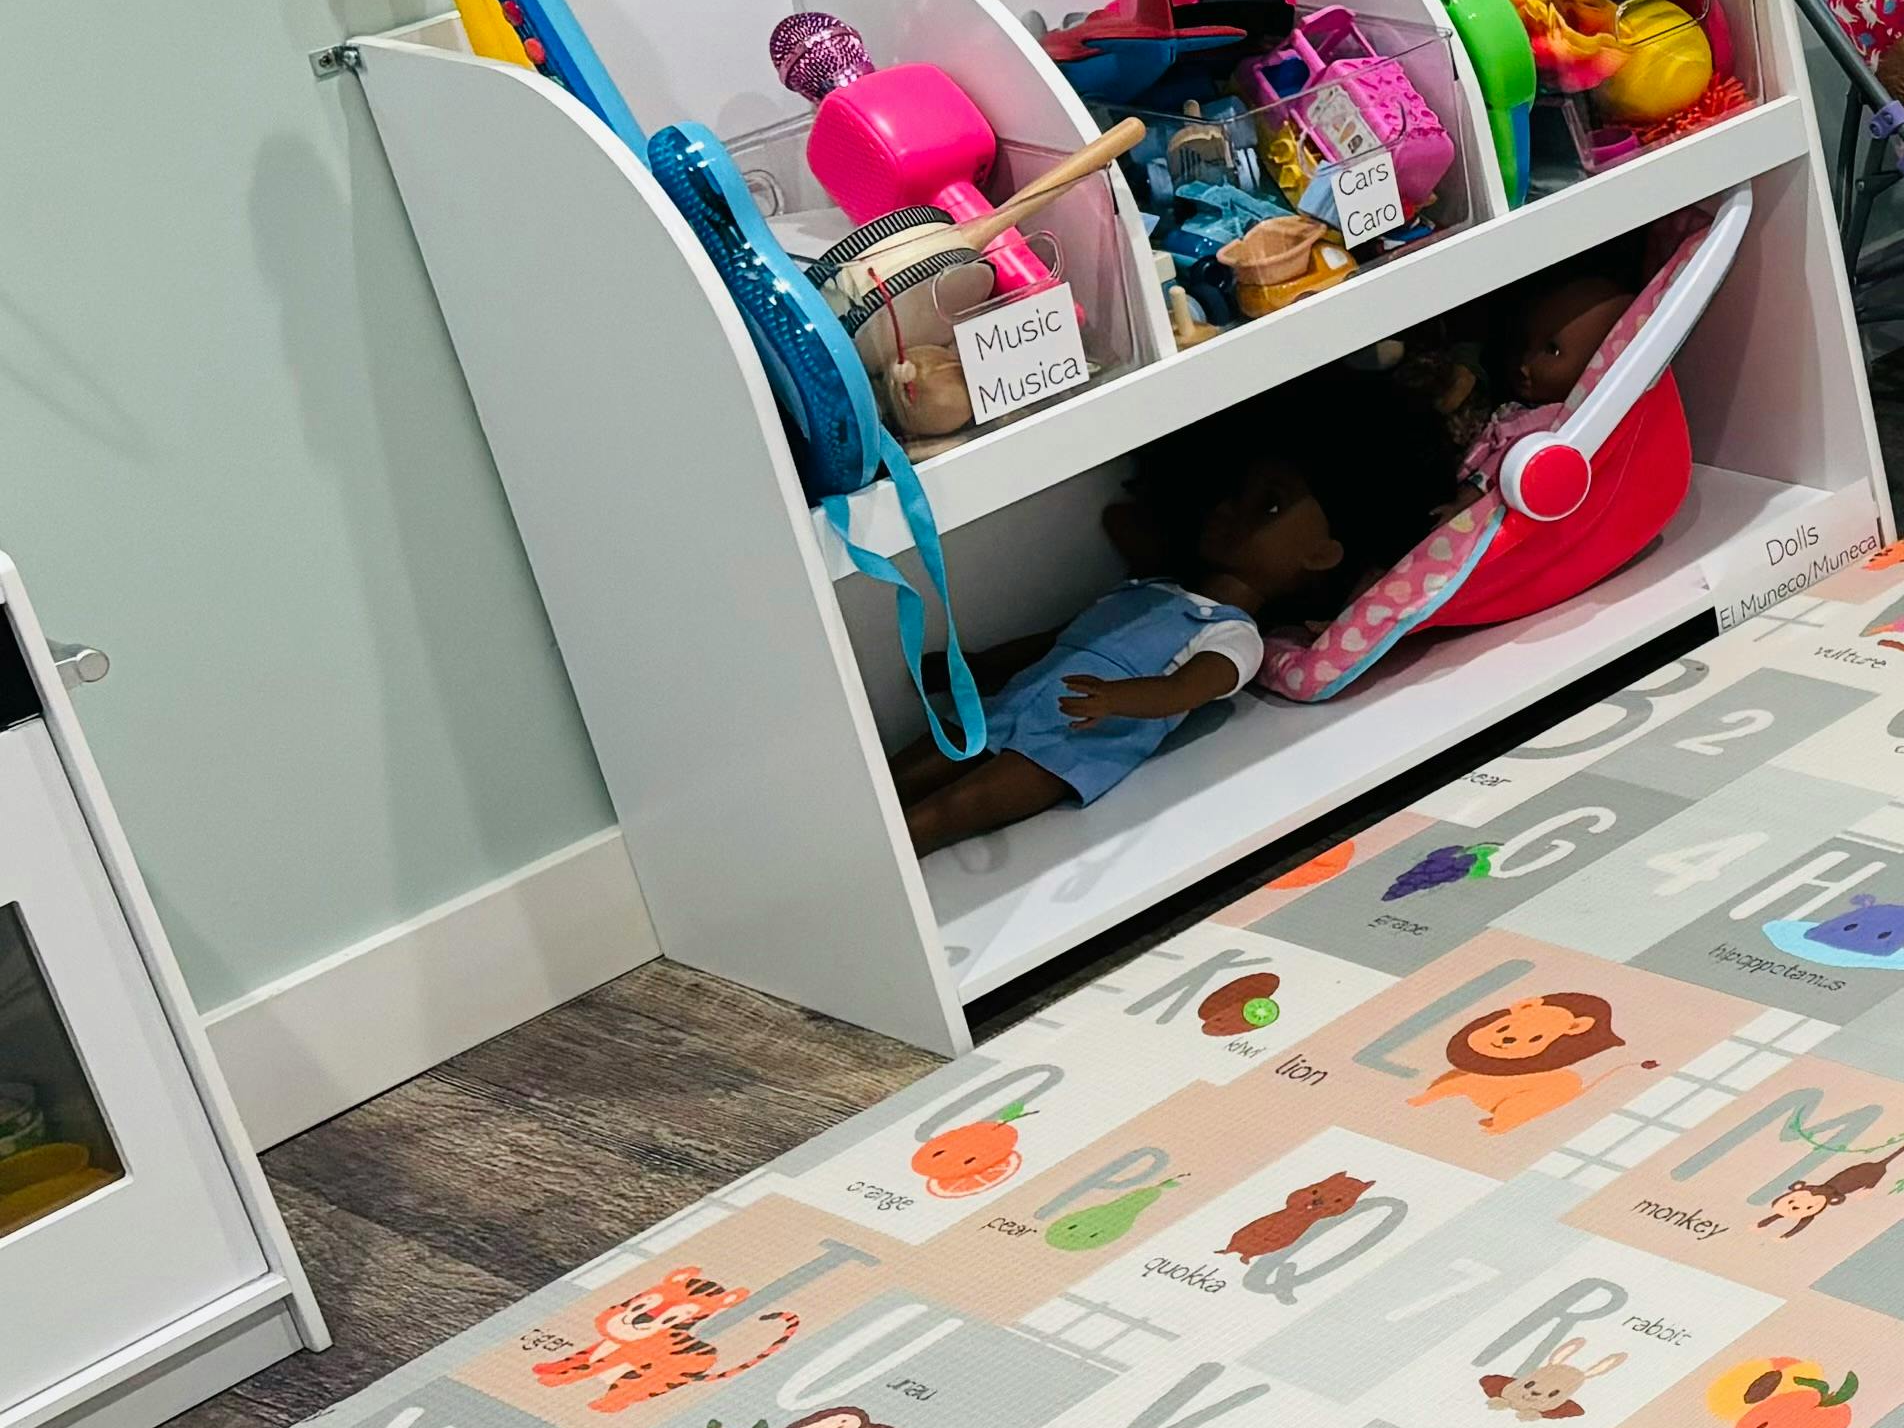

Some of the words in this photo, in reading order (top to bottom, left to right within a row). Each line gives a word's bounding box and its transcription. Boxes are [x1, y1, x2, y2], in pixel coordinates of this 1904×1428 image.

[1339, 163, 1389, 195] Cars
[1347, 204, 1397, 236] Caro
[975, 308, 1062, 361] Music
[979, 357, 1081, 414] Musica
[1766, 524, 1819, 566] Dolls
[1719, 605, 1737, 630] El
[1675, 708, 1776, 755] 2
[1489, 806, 1617, 878] G
[1645, 830, 1770, 897] 4
[1728, 850, 1888, 921] H
[1124, 948, 1272, 1025] K
[1352, 957, 1537, 1079] L
[1274, 1054, 1330, 1087] lion
[1669, 1086, 1884, 1207] M
[1034, 1145, 1170, 1221] P
[1631, 1195, 1730, 1243] monkey
[1142, 1254, 1227, 1296] quokka
[1241, 1195, 1409, 1307] Q
[777, 1302, 964, 1412] U
[1470, 1276, 1629, 1379] R
